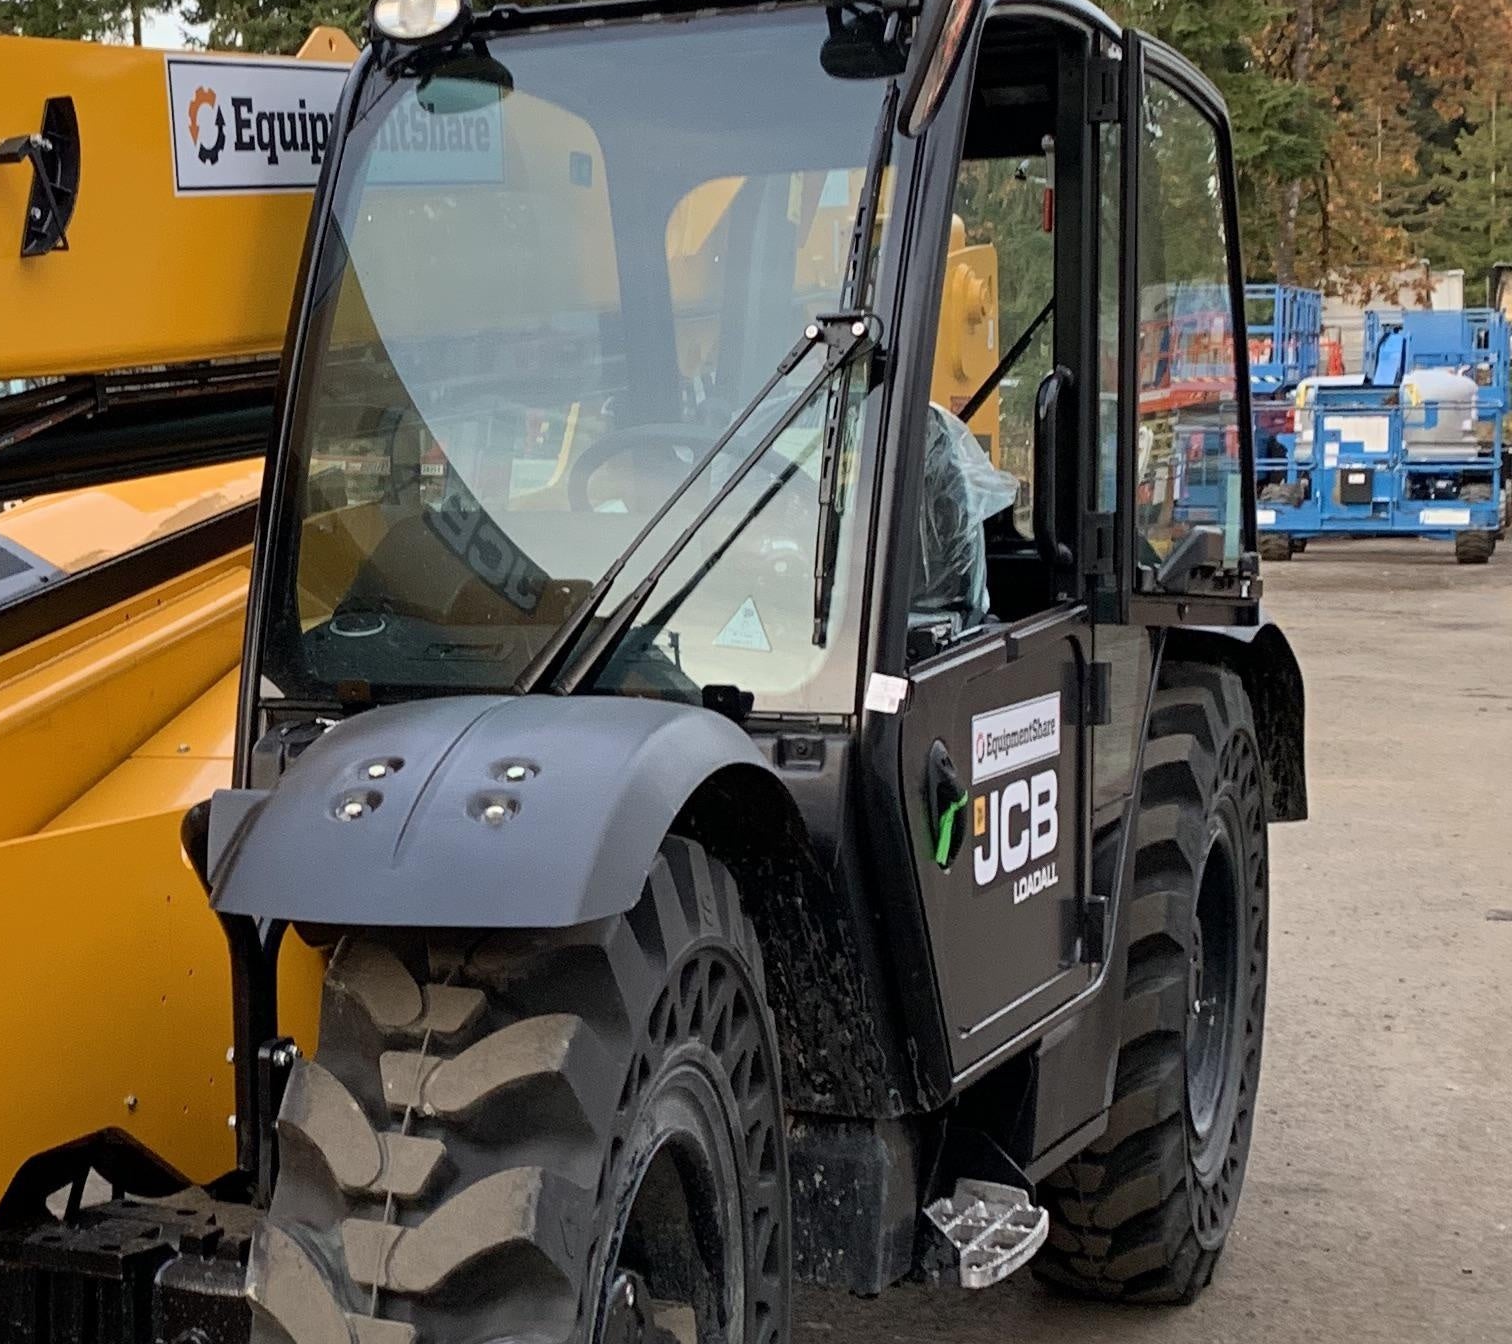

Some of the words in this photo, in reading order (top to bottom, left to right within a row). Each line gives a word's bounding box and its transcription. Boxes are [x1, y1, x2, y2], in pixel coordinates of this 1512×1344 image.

[986, 717, 1056, 760] EquipmentShare
[974, 769, 1059, 886] JCB
[1013, 862, 1059, 904] LOADALL
